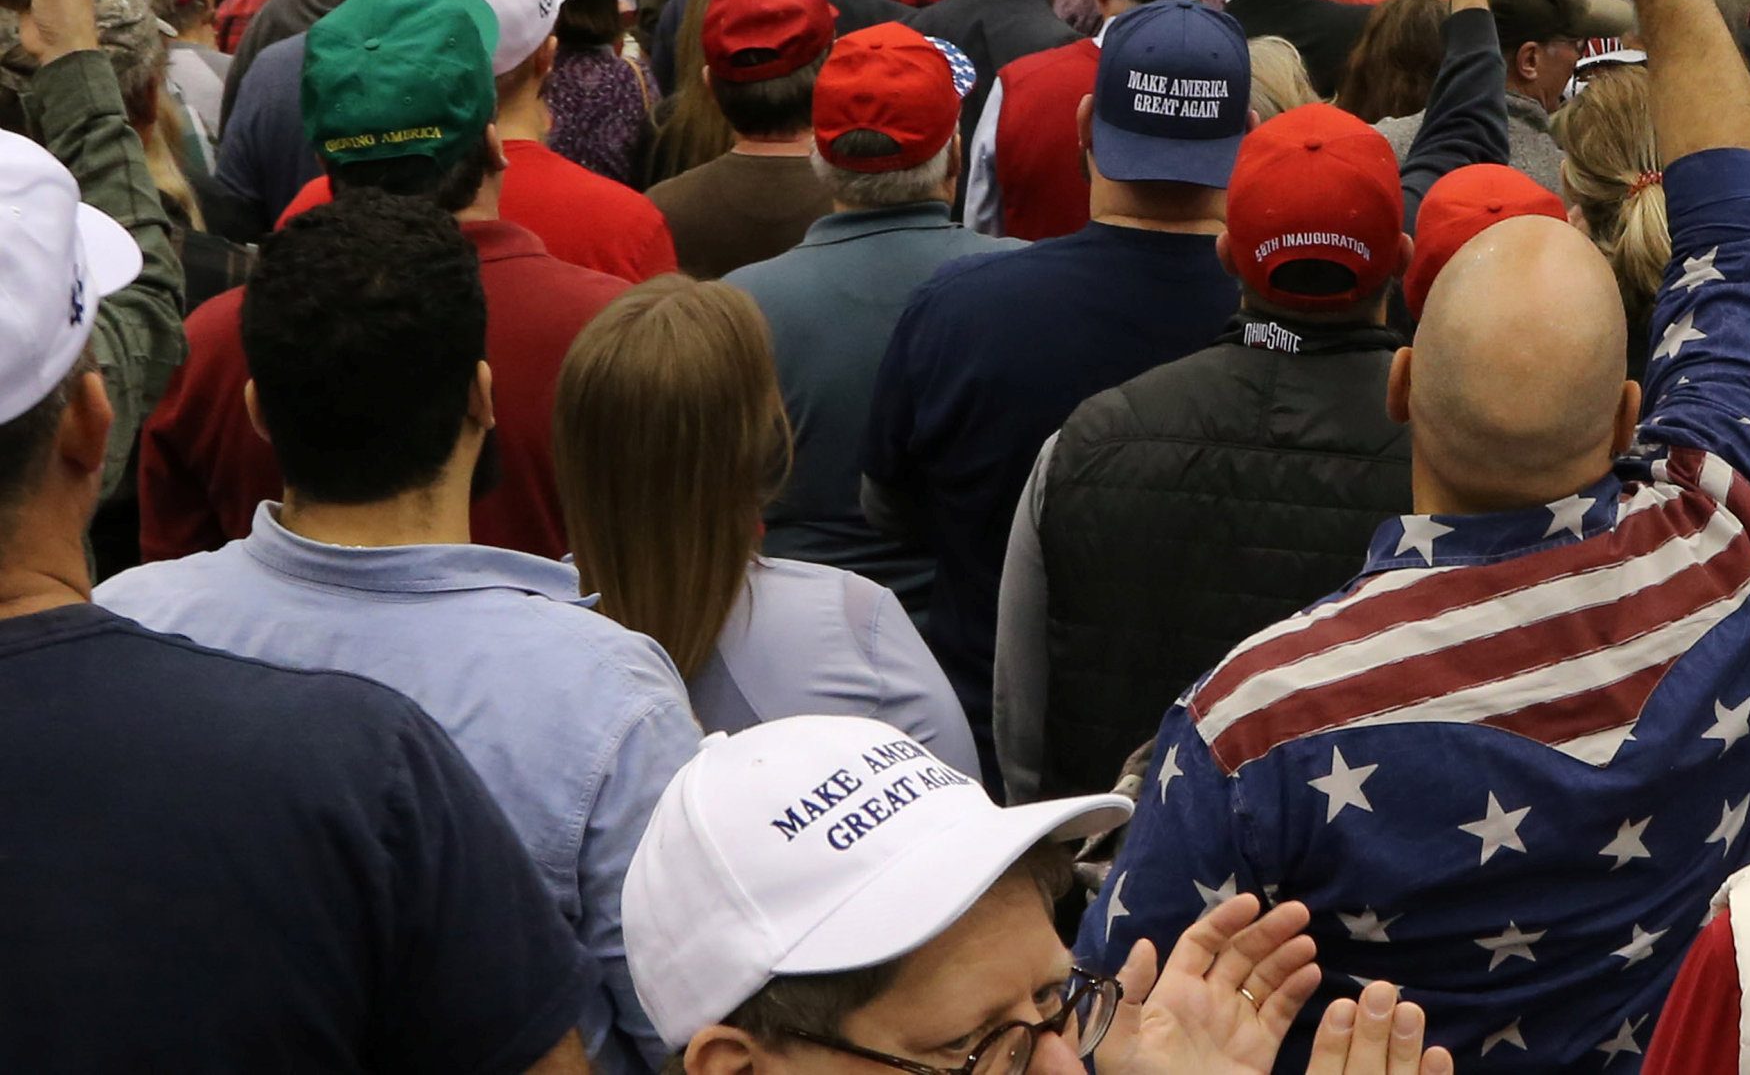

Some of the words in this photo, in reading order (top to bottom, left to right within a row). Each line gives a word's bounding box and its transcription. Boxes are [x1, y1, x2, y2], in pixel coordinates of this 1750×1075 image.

[1127, 69, 1168, 98] MAKE
[1169, 70, 1229, 99] AMERICA
[1132, 94, 1179, 119] GREAT
[1180, 96, 1220, 120] AGAIN
[381, 124, 442, 144] AMERICA
[1253, 237, 1281, 263] 58TH
[1282, 231, 1371, 262] INAUGURATION
[1264, 321, 1302, 355] STATE
[770, 768, 864, 843] MAKE
[862, 738, 928, 775] AMER
[825, 776, 925, 852] GREAT
